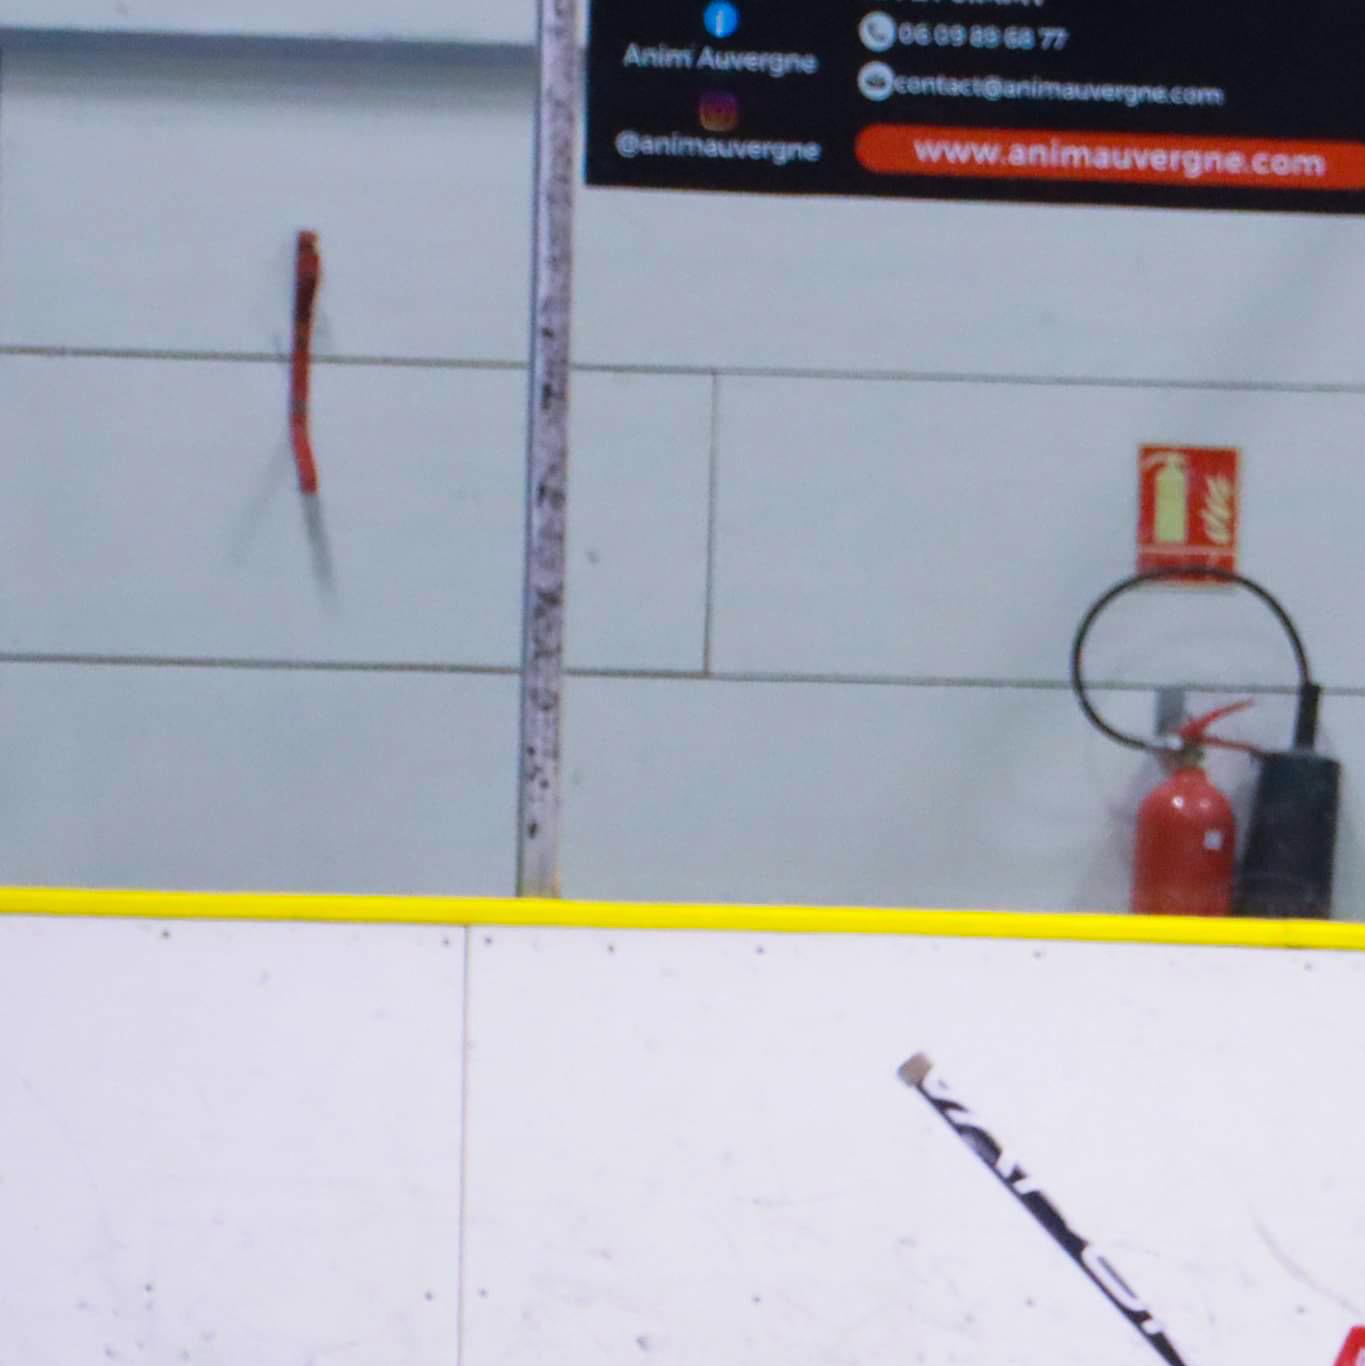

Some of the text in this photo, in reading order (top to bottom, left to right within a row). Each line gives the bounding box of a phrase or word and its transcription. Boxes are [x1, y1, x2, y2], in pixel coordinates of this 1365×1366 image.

[898, 21, 931, 46] 06
[1038, 25, 1069, 50] 77
[623, 42, 820, 78] Anim Auvergne
[895, 75, 1225, 107] contact@animauvergne.com
[615, 129, 822, 165] @animauvergne
[912, 136, 1327, 179] www.animauvergne.com
